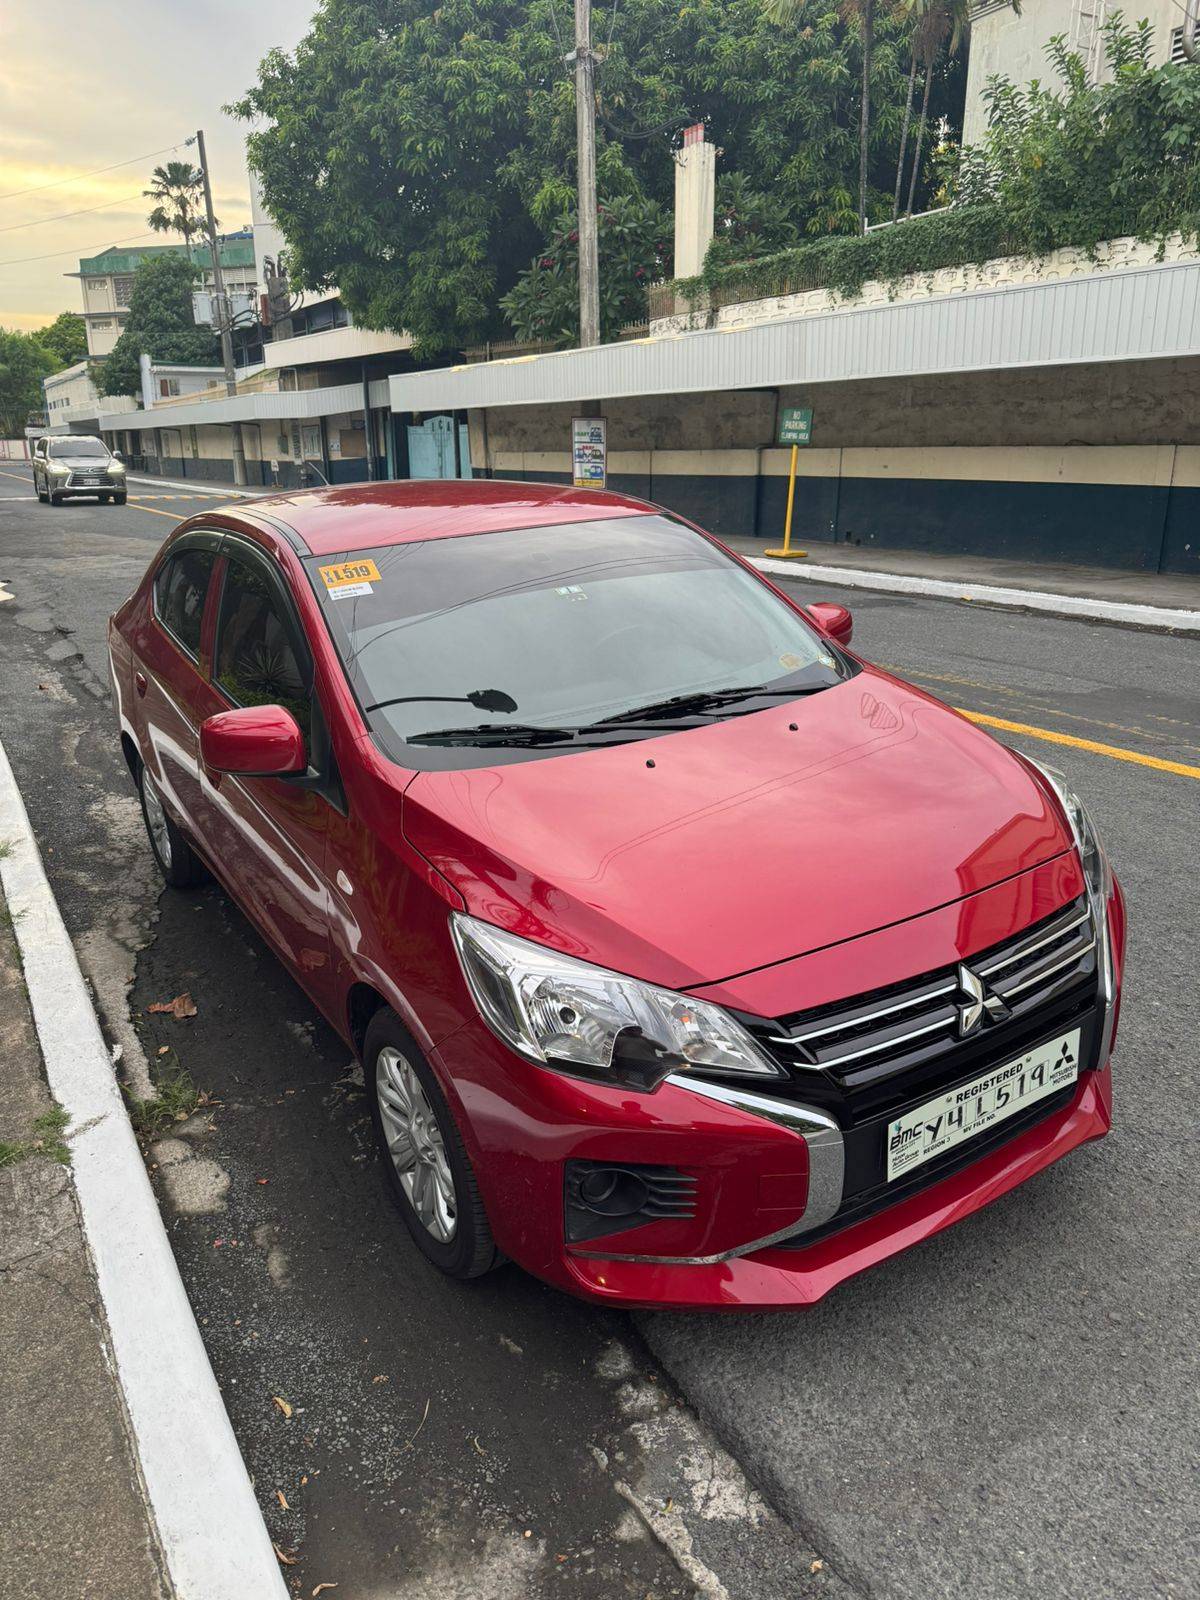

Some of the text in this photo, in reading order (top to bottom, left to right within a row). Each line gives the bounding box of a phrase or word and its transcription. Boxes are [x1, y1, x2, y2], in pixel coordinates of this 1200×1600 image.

[784, 421, 807, 430] PARKING
[956, 1063, 1023, 1104] REGISTERED
[923, 1139, 946, 1156] REGION
